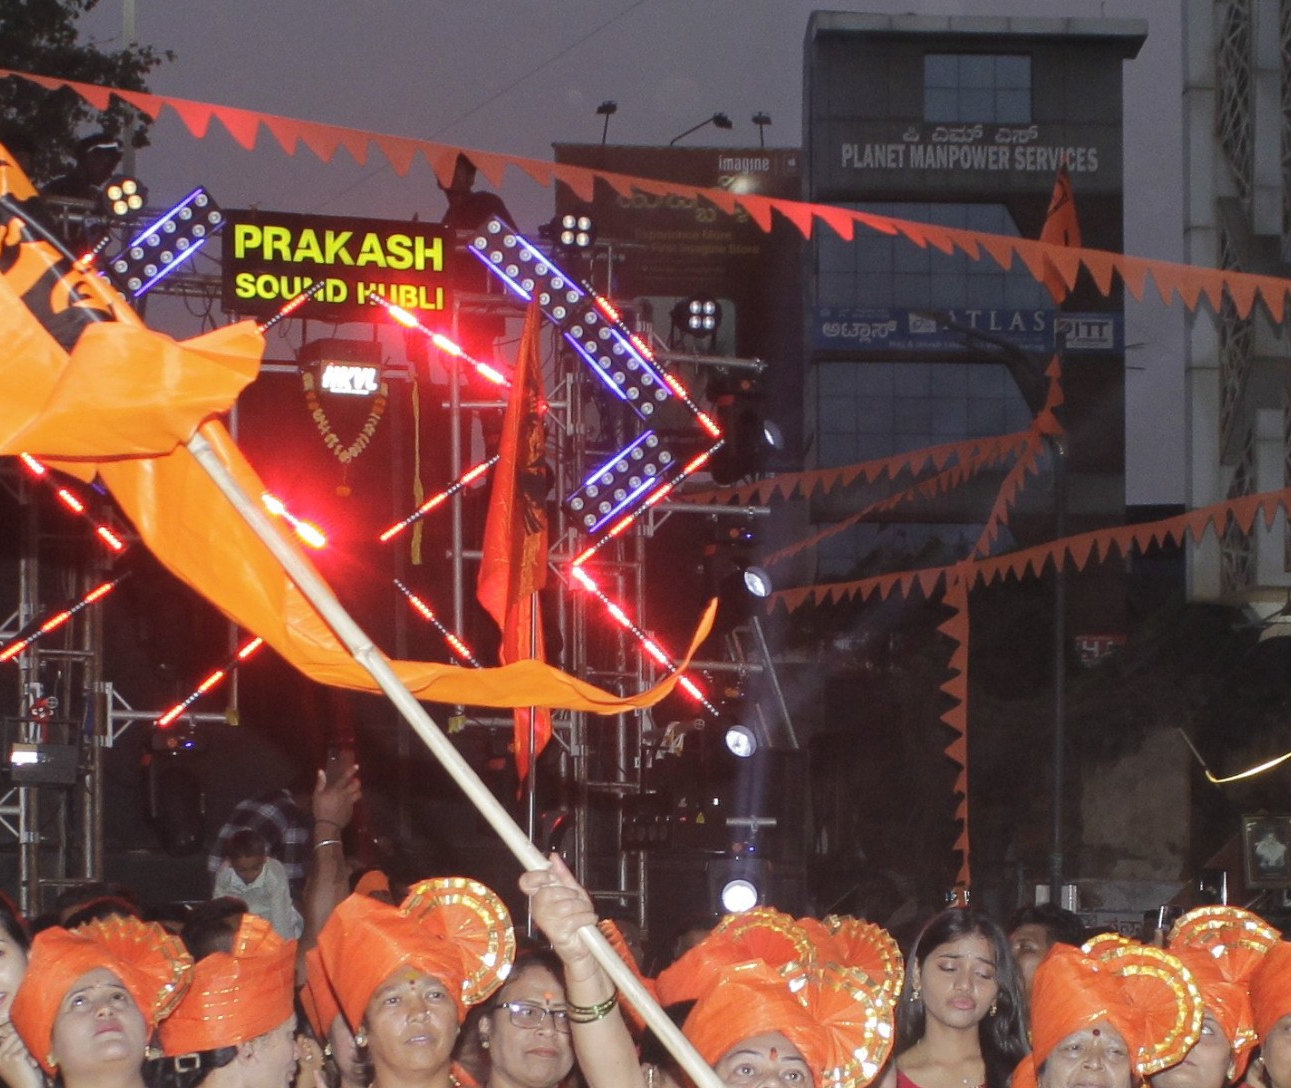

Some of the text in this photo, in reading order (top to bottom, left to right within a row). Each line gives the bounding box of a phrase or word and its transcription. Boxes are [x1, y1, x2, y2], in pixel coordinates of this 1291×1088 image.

[718, 154, 770, 174] imagine
[841, 143, 1099, 171] PLANET MANPOWER SERVICES
[234, 224, 443, 271] PRAKASH
[357, 281, 444, 310] HUBLI
